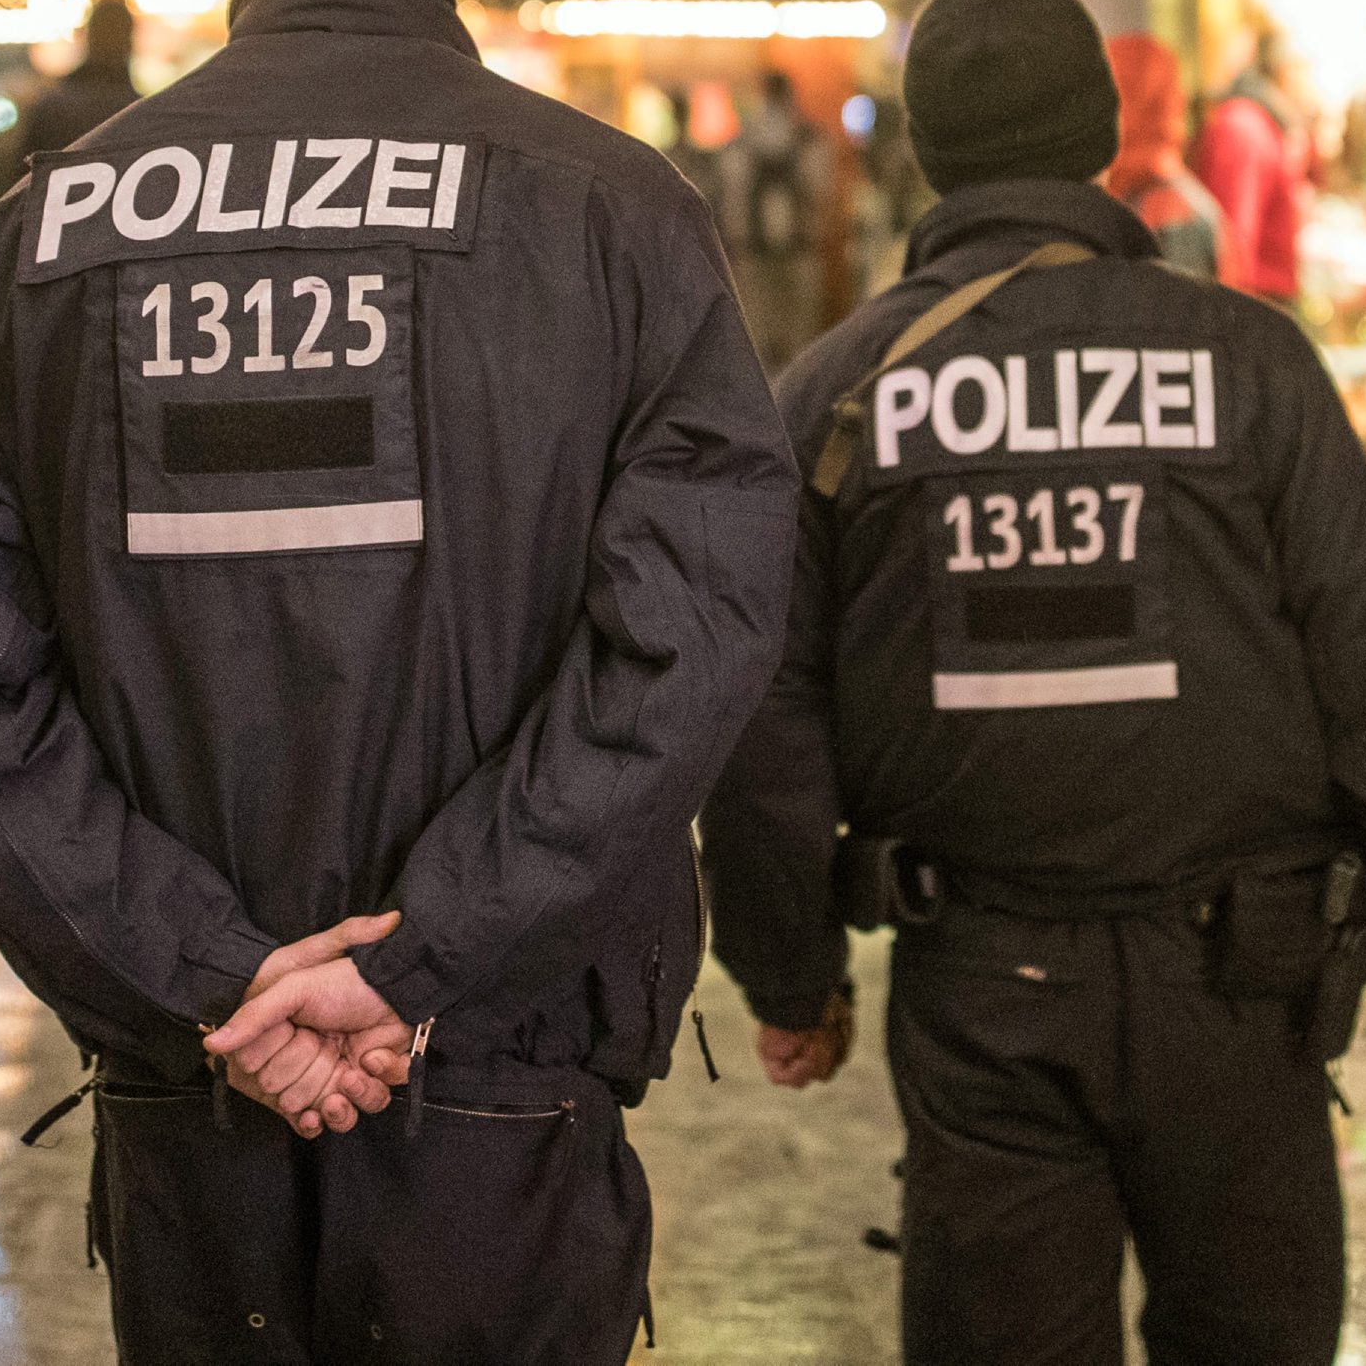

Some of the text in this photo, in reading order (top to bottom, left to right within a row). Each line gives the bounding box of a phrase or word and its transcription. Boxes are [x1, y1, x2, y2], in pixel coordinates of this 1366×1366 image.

[36, 138, 466, 264] POLIZEI
[142, 274, 387, 377] 13125
[874, 348, 1217, 468] POLIZEI
[943, 483, 1145, 572] 13137
